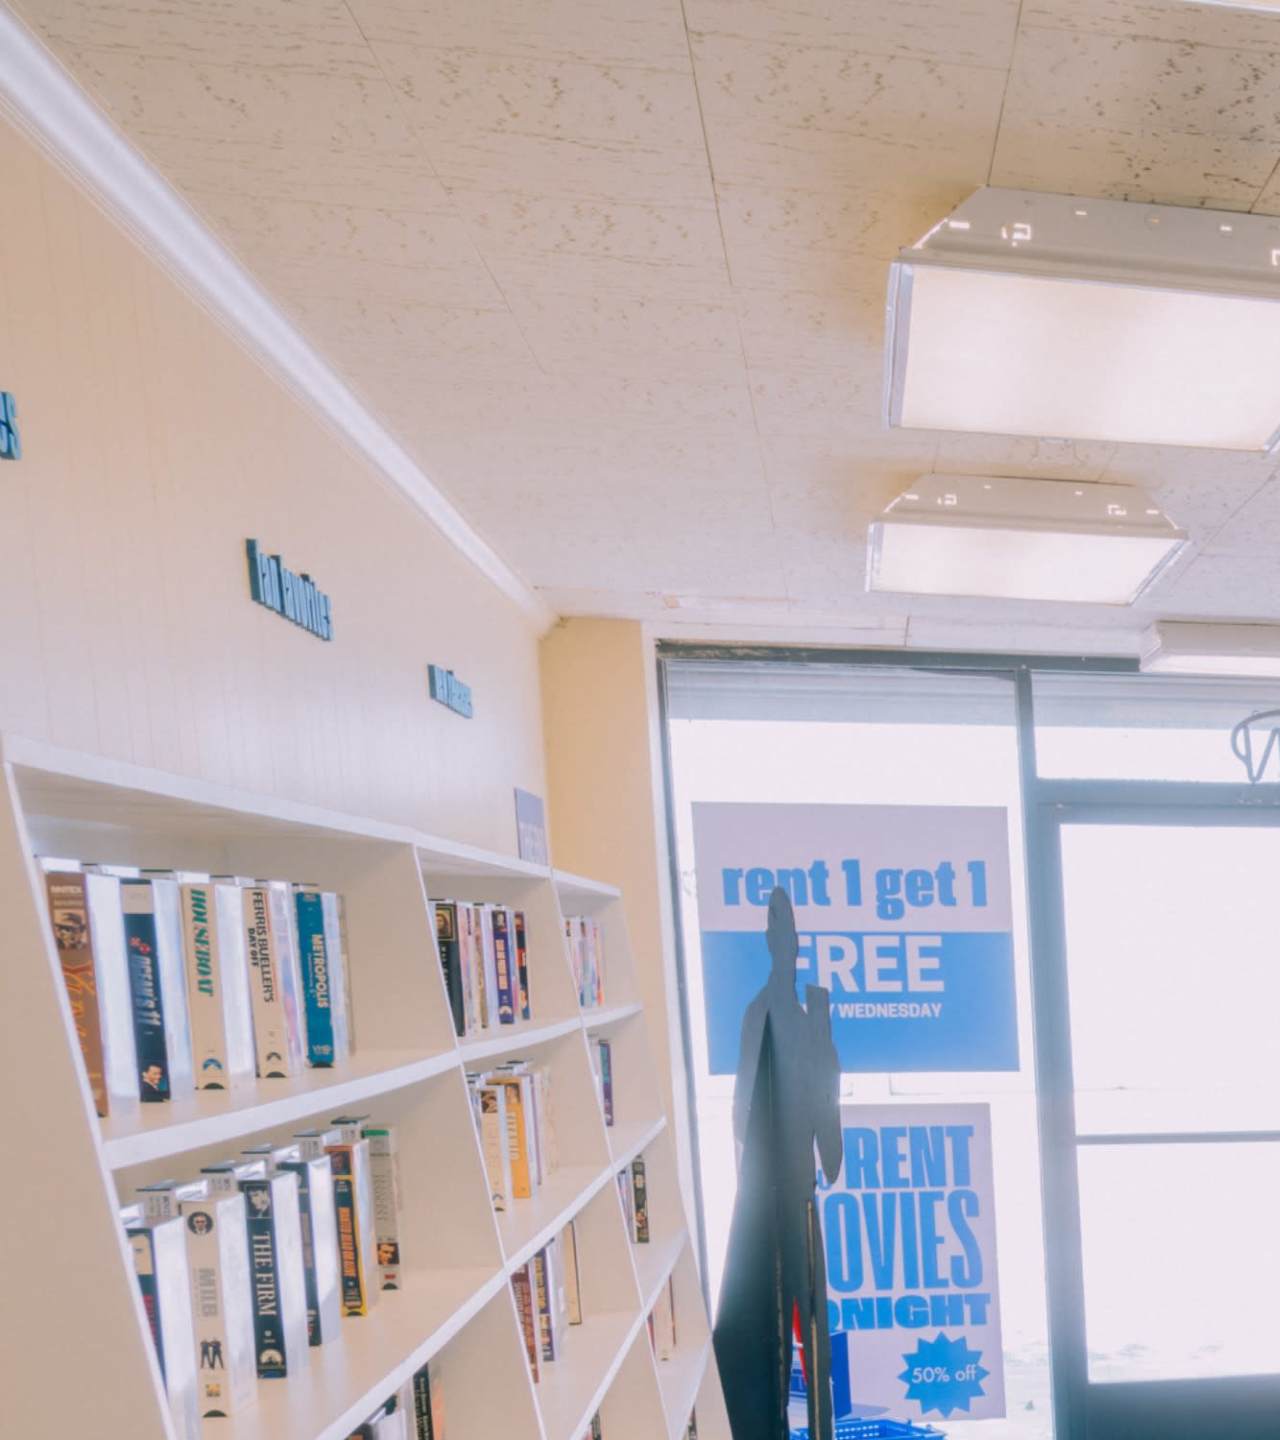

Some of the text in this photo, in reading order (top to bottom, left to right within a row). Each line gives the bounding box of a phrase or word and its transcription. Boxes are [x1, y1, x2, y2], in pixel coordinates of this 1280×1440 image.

[722, 859, 987, 920] rent 1 get 1
[190, 888, 214, 997] HOUSEBOAT
[247, 927, 259, 967] DAY OFF
[252, 891, 274, 1003] FERRIS BUELLER'S
[311, 933, 330, 1009] METROPOLIS
[839, 1003, 942, 1019] WEDNESDAY
[844, 1125, 974, 1189] RENT
[252, 1231, 278, 1317] THE FIRM
[817, 1191, 984, 1293] OVIES
[828, 1294, 990, 1330] NIGHT
[912, 1365, 977, 1385] 50% off
